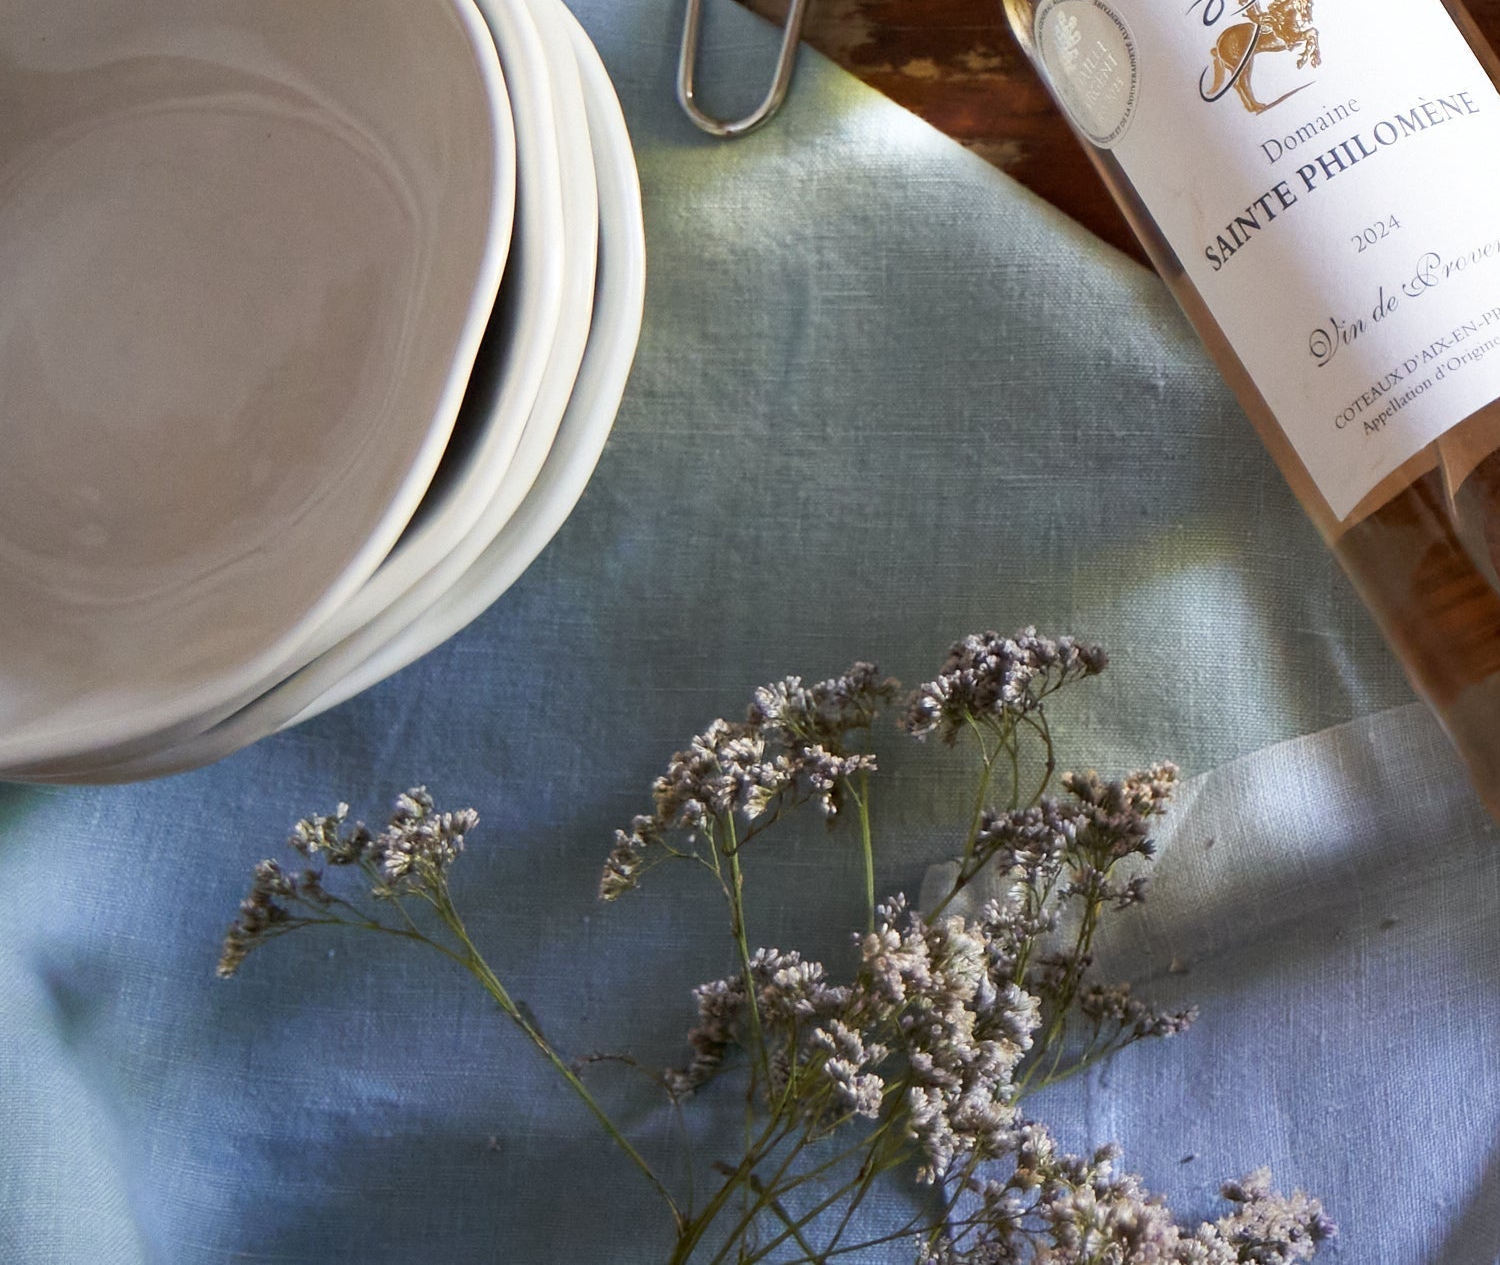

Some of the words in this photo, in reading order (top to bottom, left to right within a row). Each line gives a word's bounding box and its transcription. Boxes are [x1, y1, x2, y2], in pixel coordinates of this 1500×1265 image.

[1260, 96, 1361, 165] Domaine
[1205, 180, 1298, 272] SAINTE
[1296, 91, 1480, 193] PHILOMÈNE
[1351, 214, 1402, 254] 2024
[1309, 317, 1367, 368] Vin
[1372, 286, 1399, 323] de
[1334, 368, 1405, 430] COTEAUX
[1362, 380, 1433, 436] Appellation
[1435, 335, 1500, 382] d'Origine
